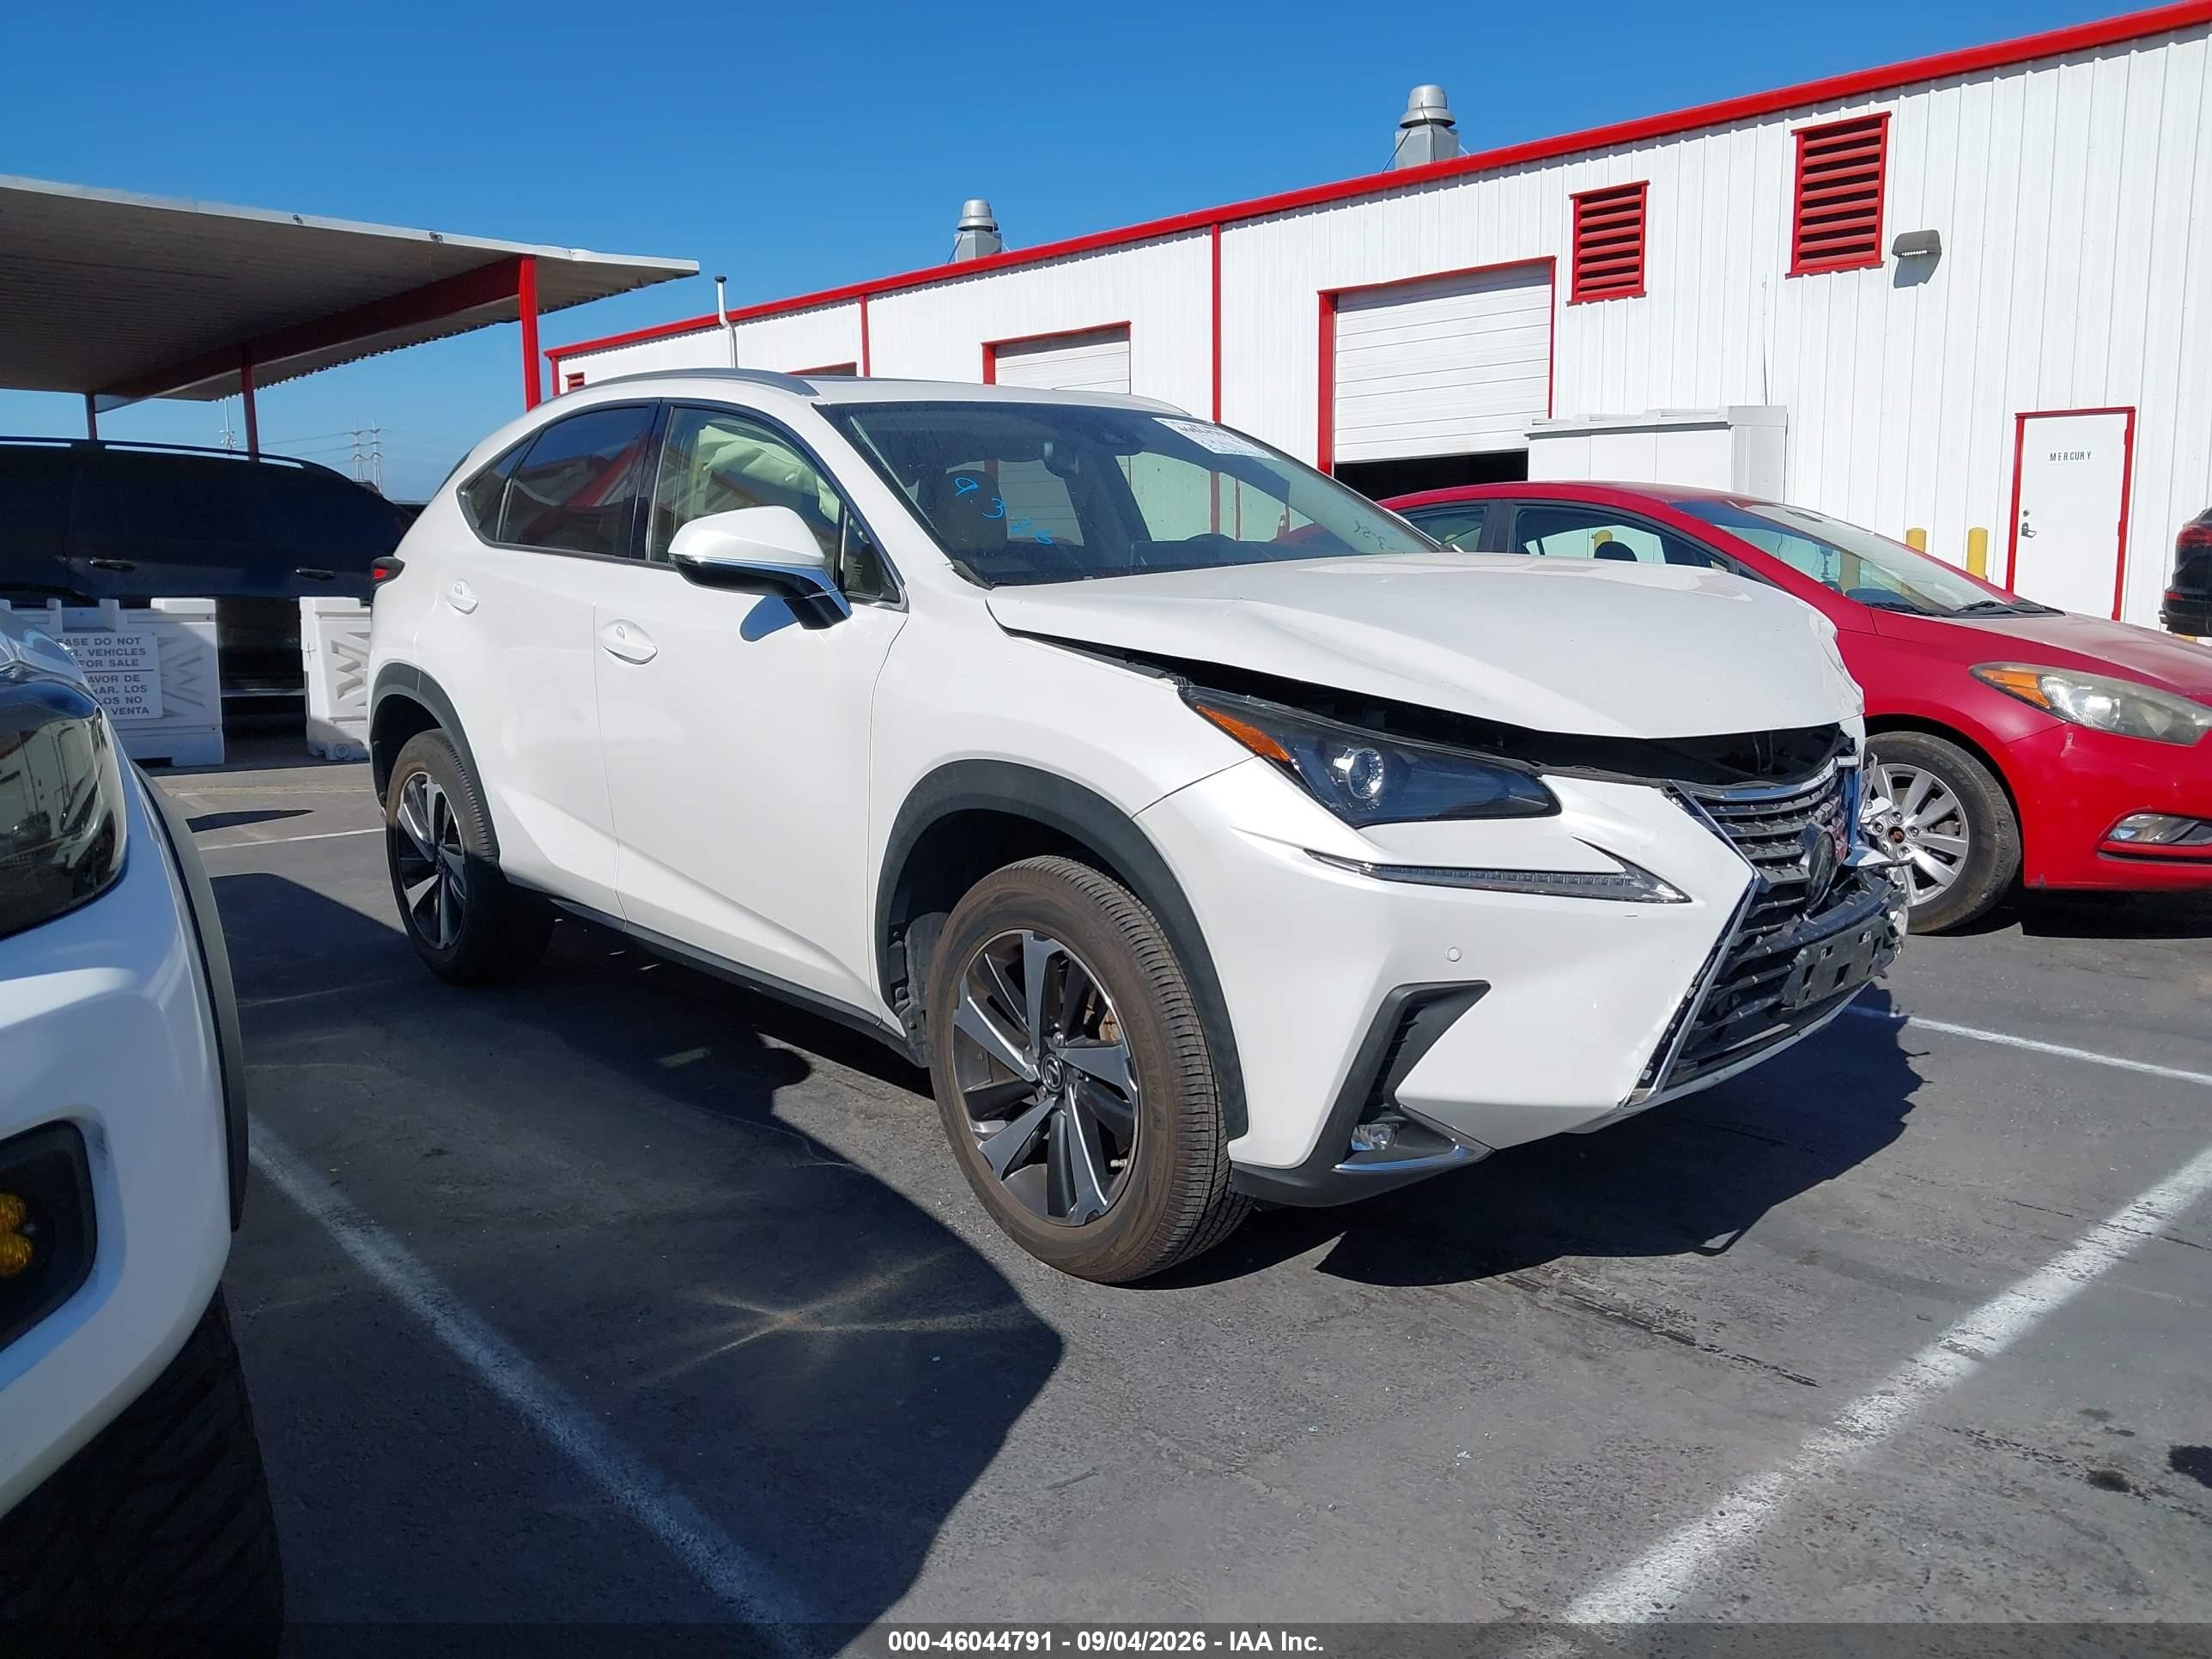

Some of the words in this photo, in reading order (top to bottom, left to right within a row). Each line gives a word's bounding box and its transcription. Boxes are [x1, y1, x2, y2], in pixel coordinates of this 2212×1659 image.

[2049, 451, 2092, 462] MERCURY
[56, 638, 88, 647] EASE
[94, 637, 112, 646] DO
[88, 648, 146, 657] VEHICLES
[109, 659, 139, 667] SALE
[88, 675, 118, 684] AVOR
[124, 674, 141, 683] DE
[125, 685, 148, 694] LOS
[125, 696, 143, 704] NO
[111, 707, 149, 715] VENTA
